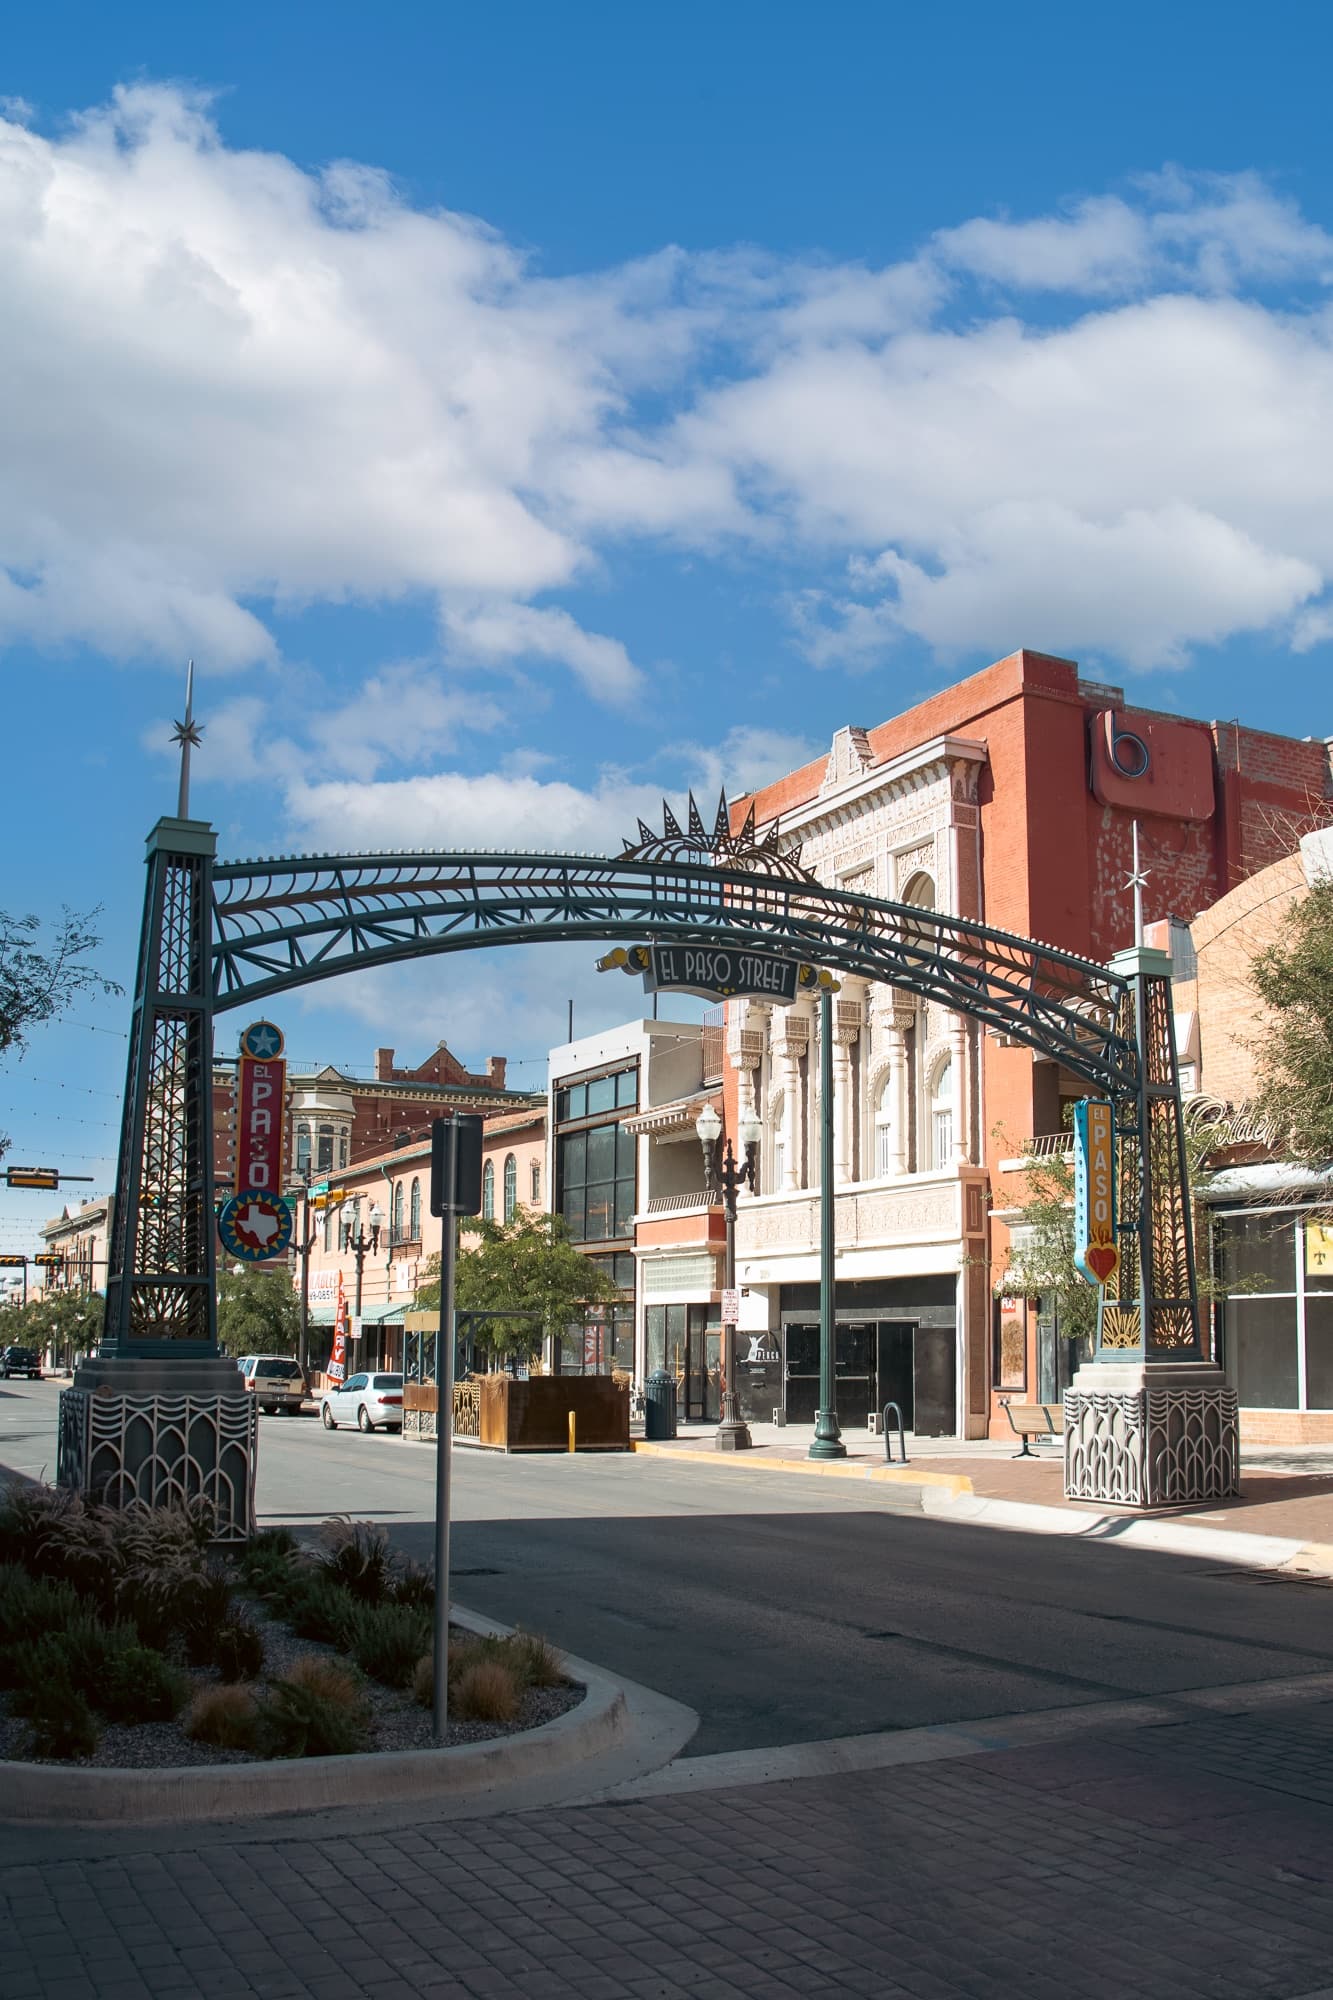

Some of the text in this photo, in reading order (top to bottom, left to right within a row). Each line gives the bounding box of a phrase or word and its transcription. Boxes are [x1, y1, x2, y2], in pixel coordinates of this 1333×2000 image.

[660, 951, 790, 992] EL PASO STREET
[253, 1064, 272, 1079] EL
[1093, 1107, 1107, 1121] EL
[248, 1082, 272, 1188] PASO
[1094, 1124, 1108, 1222] PASO
